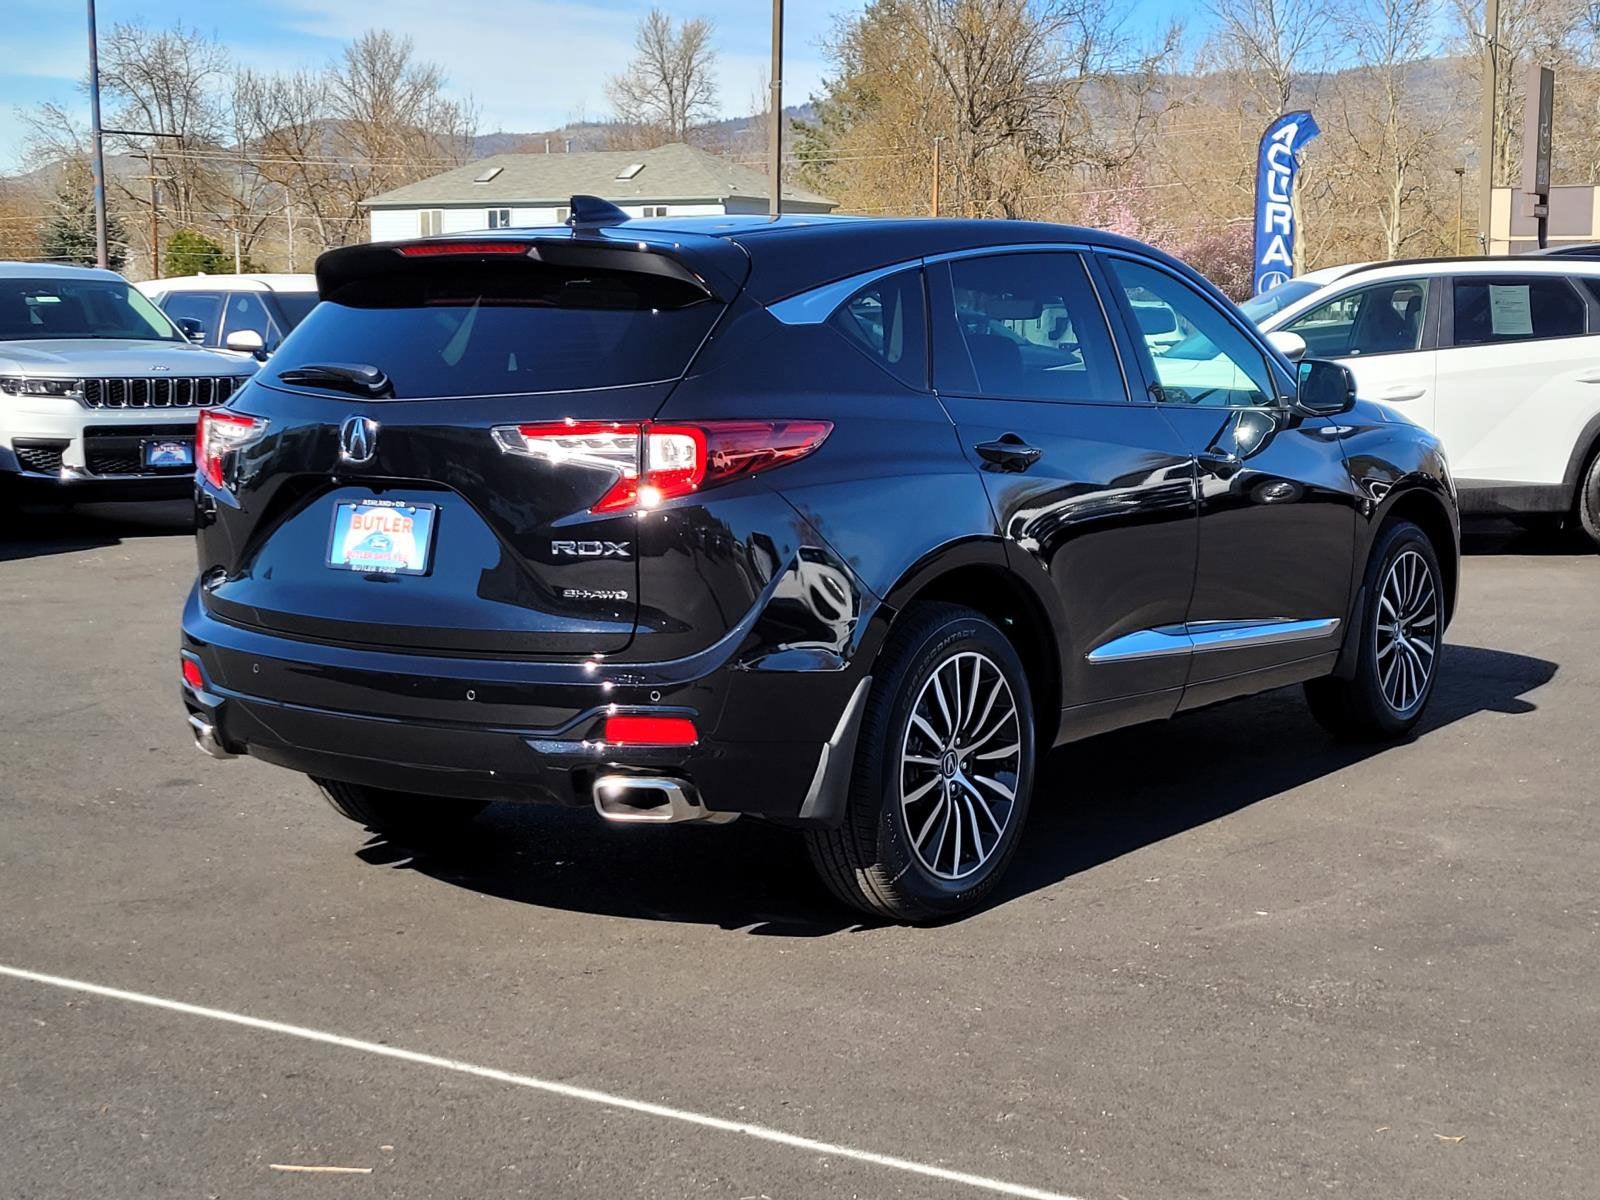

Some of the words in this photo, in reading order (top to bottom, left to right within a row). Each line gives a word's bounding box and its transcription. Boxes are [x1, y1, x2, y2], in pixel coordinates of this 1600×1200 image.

[1261, 122, 1299, 266] ACURA
[352, 515, 412, 532] BUTLER
[551, 540, 631, 556] RDX
